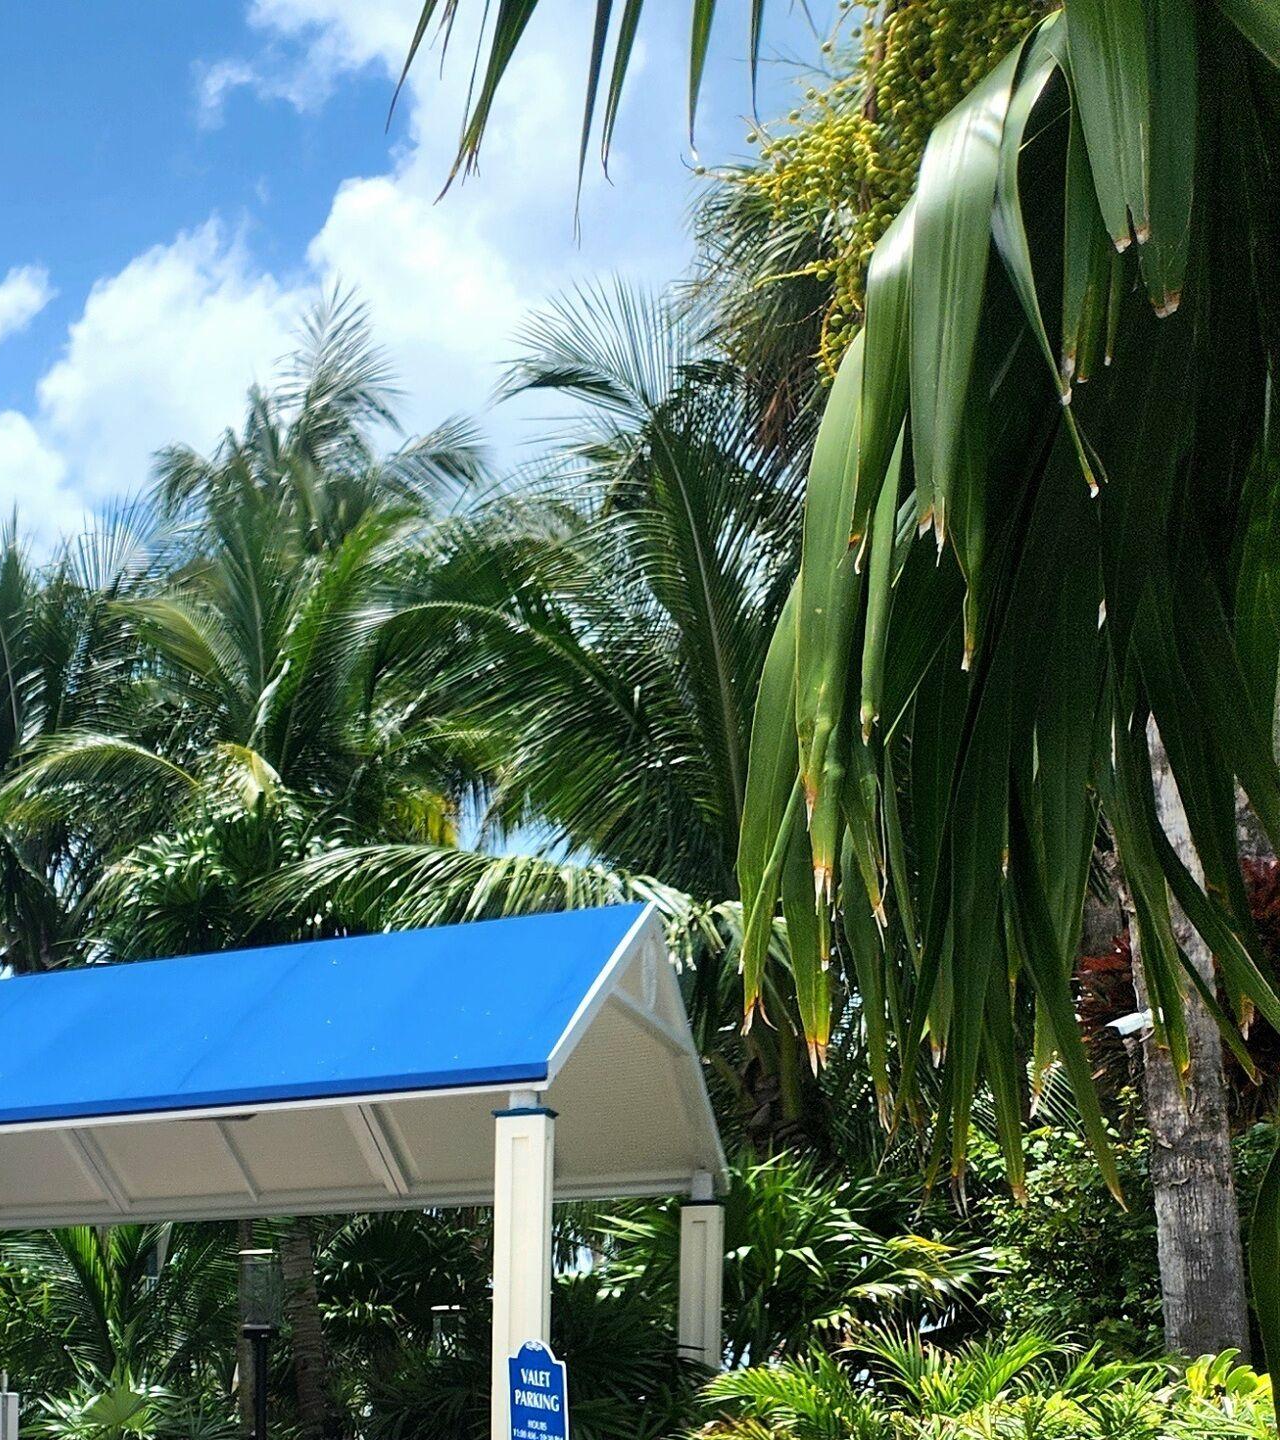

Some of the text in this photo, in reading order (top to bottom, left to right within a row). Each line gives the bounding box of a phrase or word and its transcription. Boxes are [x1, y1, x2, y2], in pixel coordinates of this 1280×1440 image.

[521, 1369, 550, 1388] VALET
[514, 1389, 560, 1412] PARKING
[528, 1420, 547, 1431] HOURS
